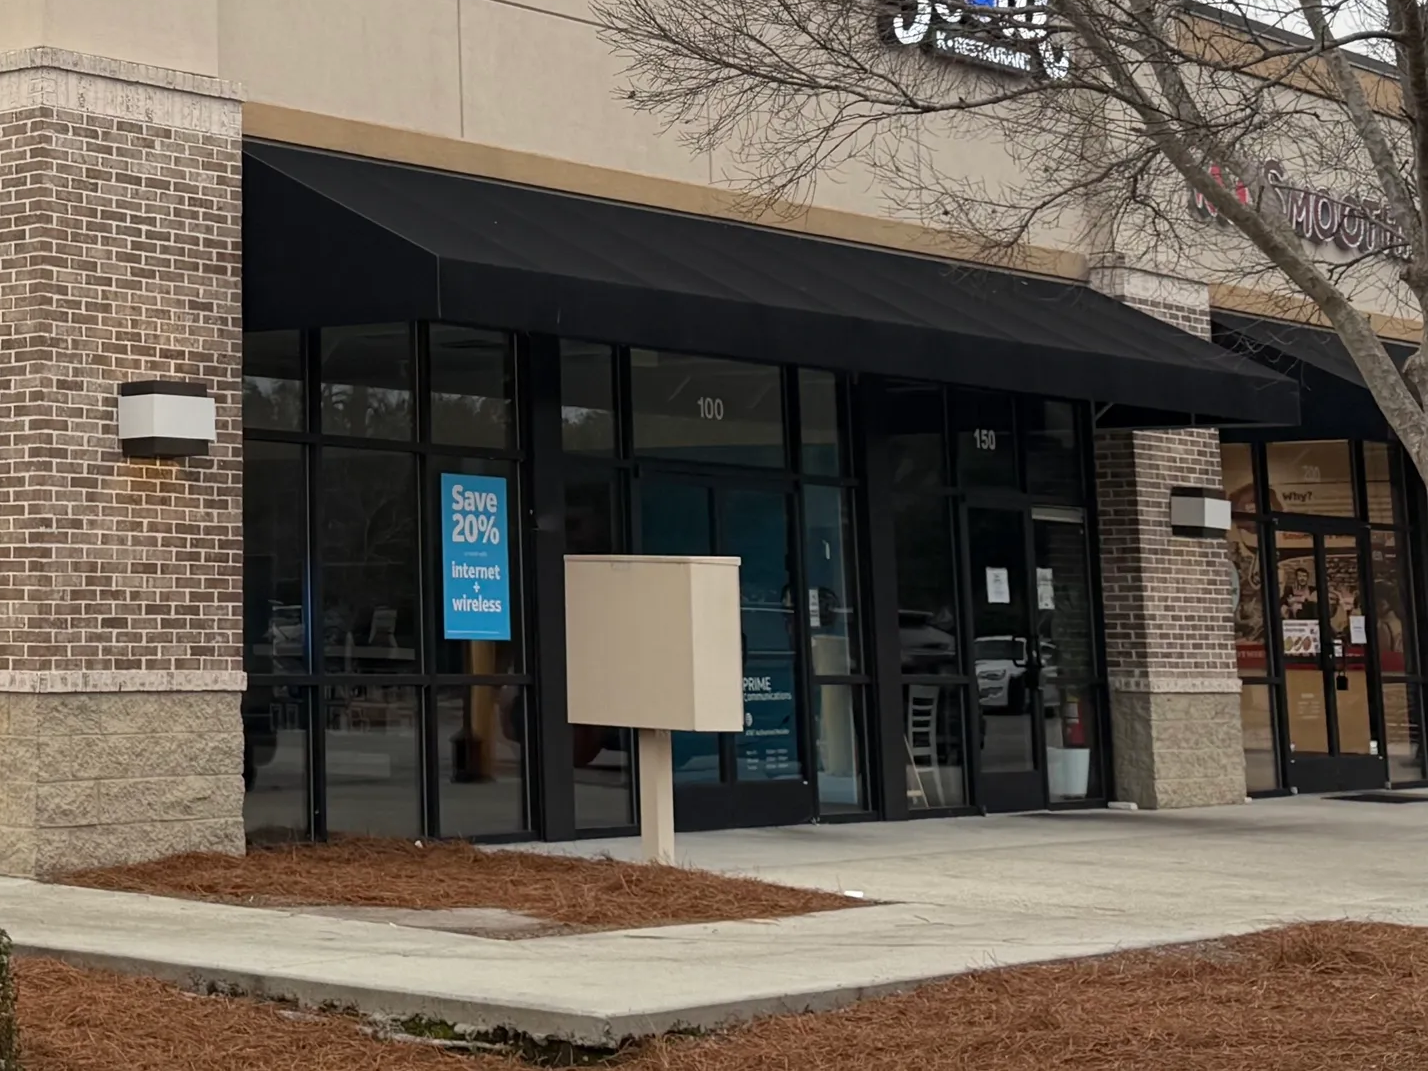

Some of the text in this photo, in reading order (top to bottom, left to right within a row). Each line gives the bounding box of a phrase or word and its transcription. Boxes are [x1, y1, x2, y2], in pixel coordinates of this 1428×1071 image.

[697, 396, 724, 420] 100
[973, 428, 996, 450] 150
[451, 484, 498, 513] Save
[1282, 490, 1313, 503] Why?
[452, 513, 500, 545] 20%
[451, 561, 501, 580] internet
[452, 594, 502, 613] wireless
[743, 676, 772, 691] PRIME
